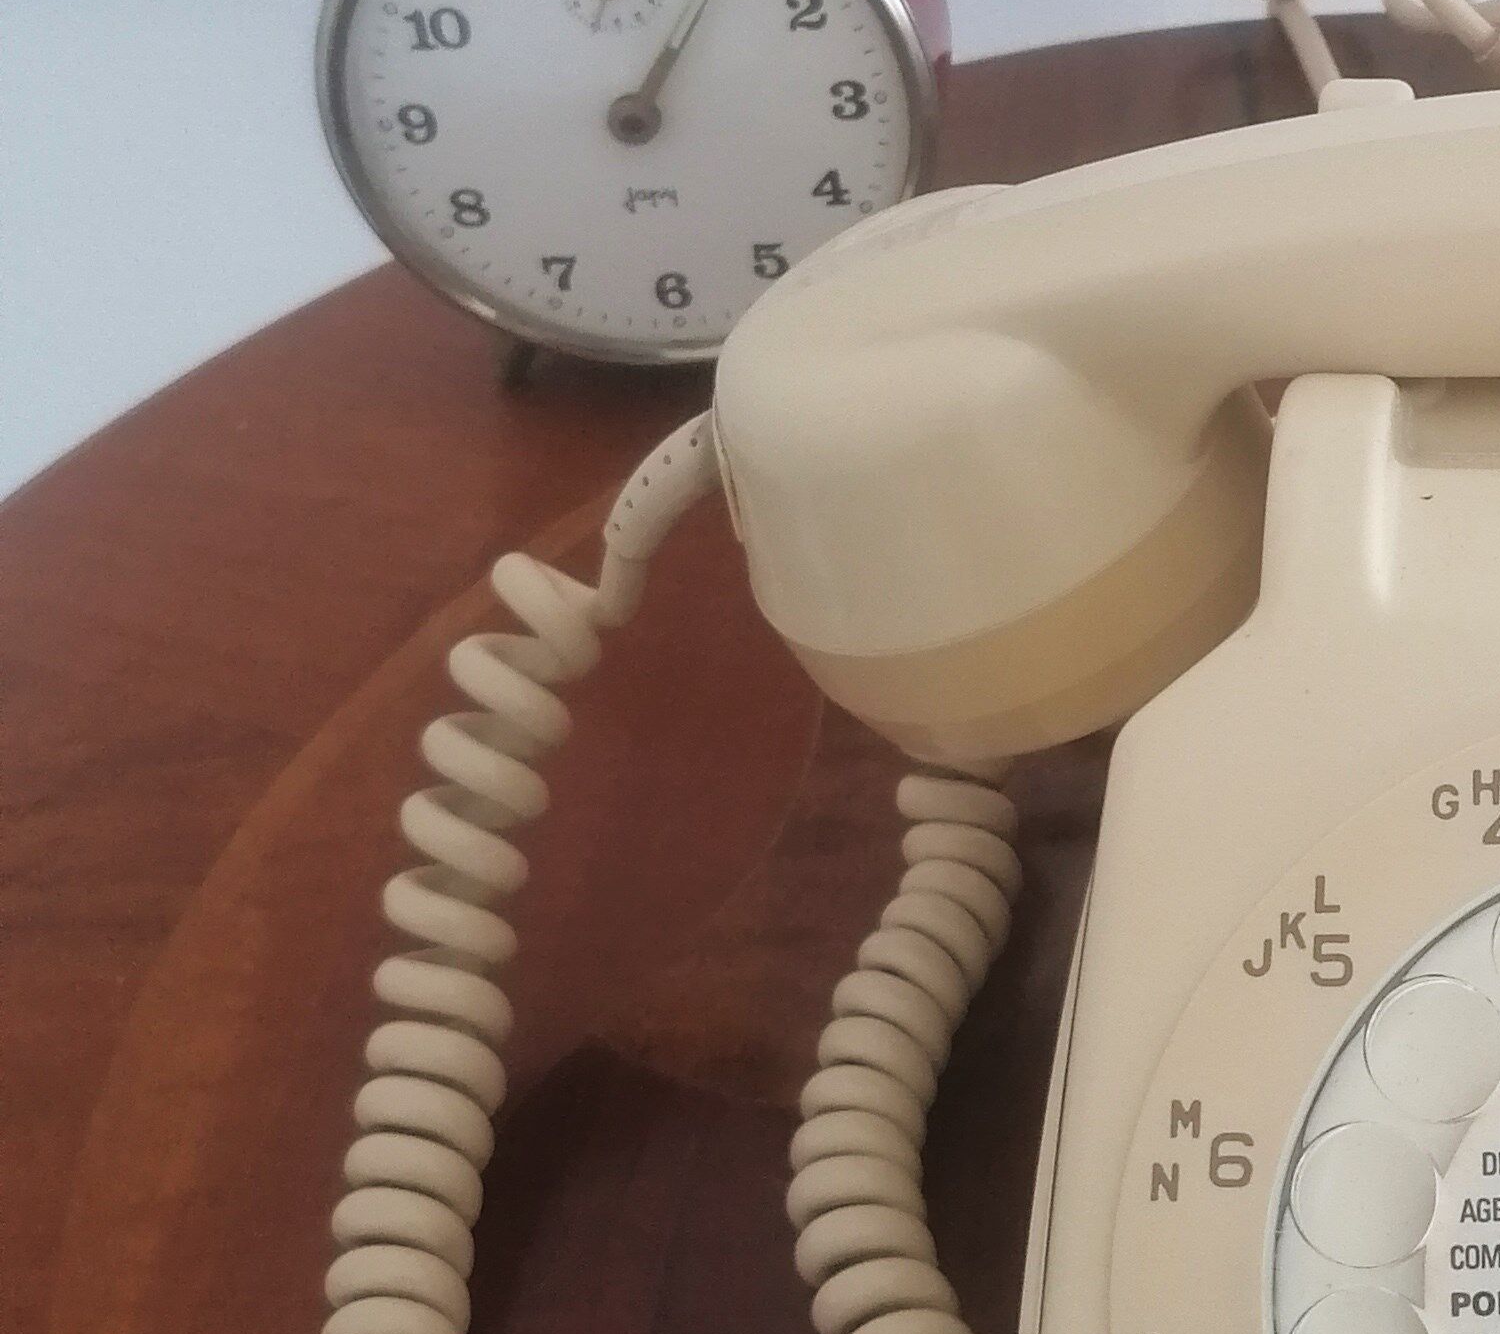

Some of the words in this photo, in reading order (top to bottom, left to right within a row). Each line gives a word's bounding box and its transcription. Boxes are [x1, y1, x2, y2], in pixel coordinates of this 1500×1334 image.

[403, 8, 470, 50] 10
[830, 80, 870, 119] 3
[398, 104, 437, 144] 9
[450, 188, 491, 226] 8
[813, 170, 850, 206] 4
[541, 256, 577, 291] 7
[753, 244, 789, 278] 5
[655, 273, 692, 308] 6
[1310, 934, 1353, 987] 5
[1208, 1132, 1254, 1188] 6
